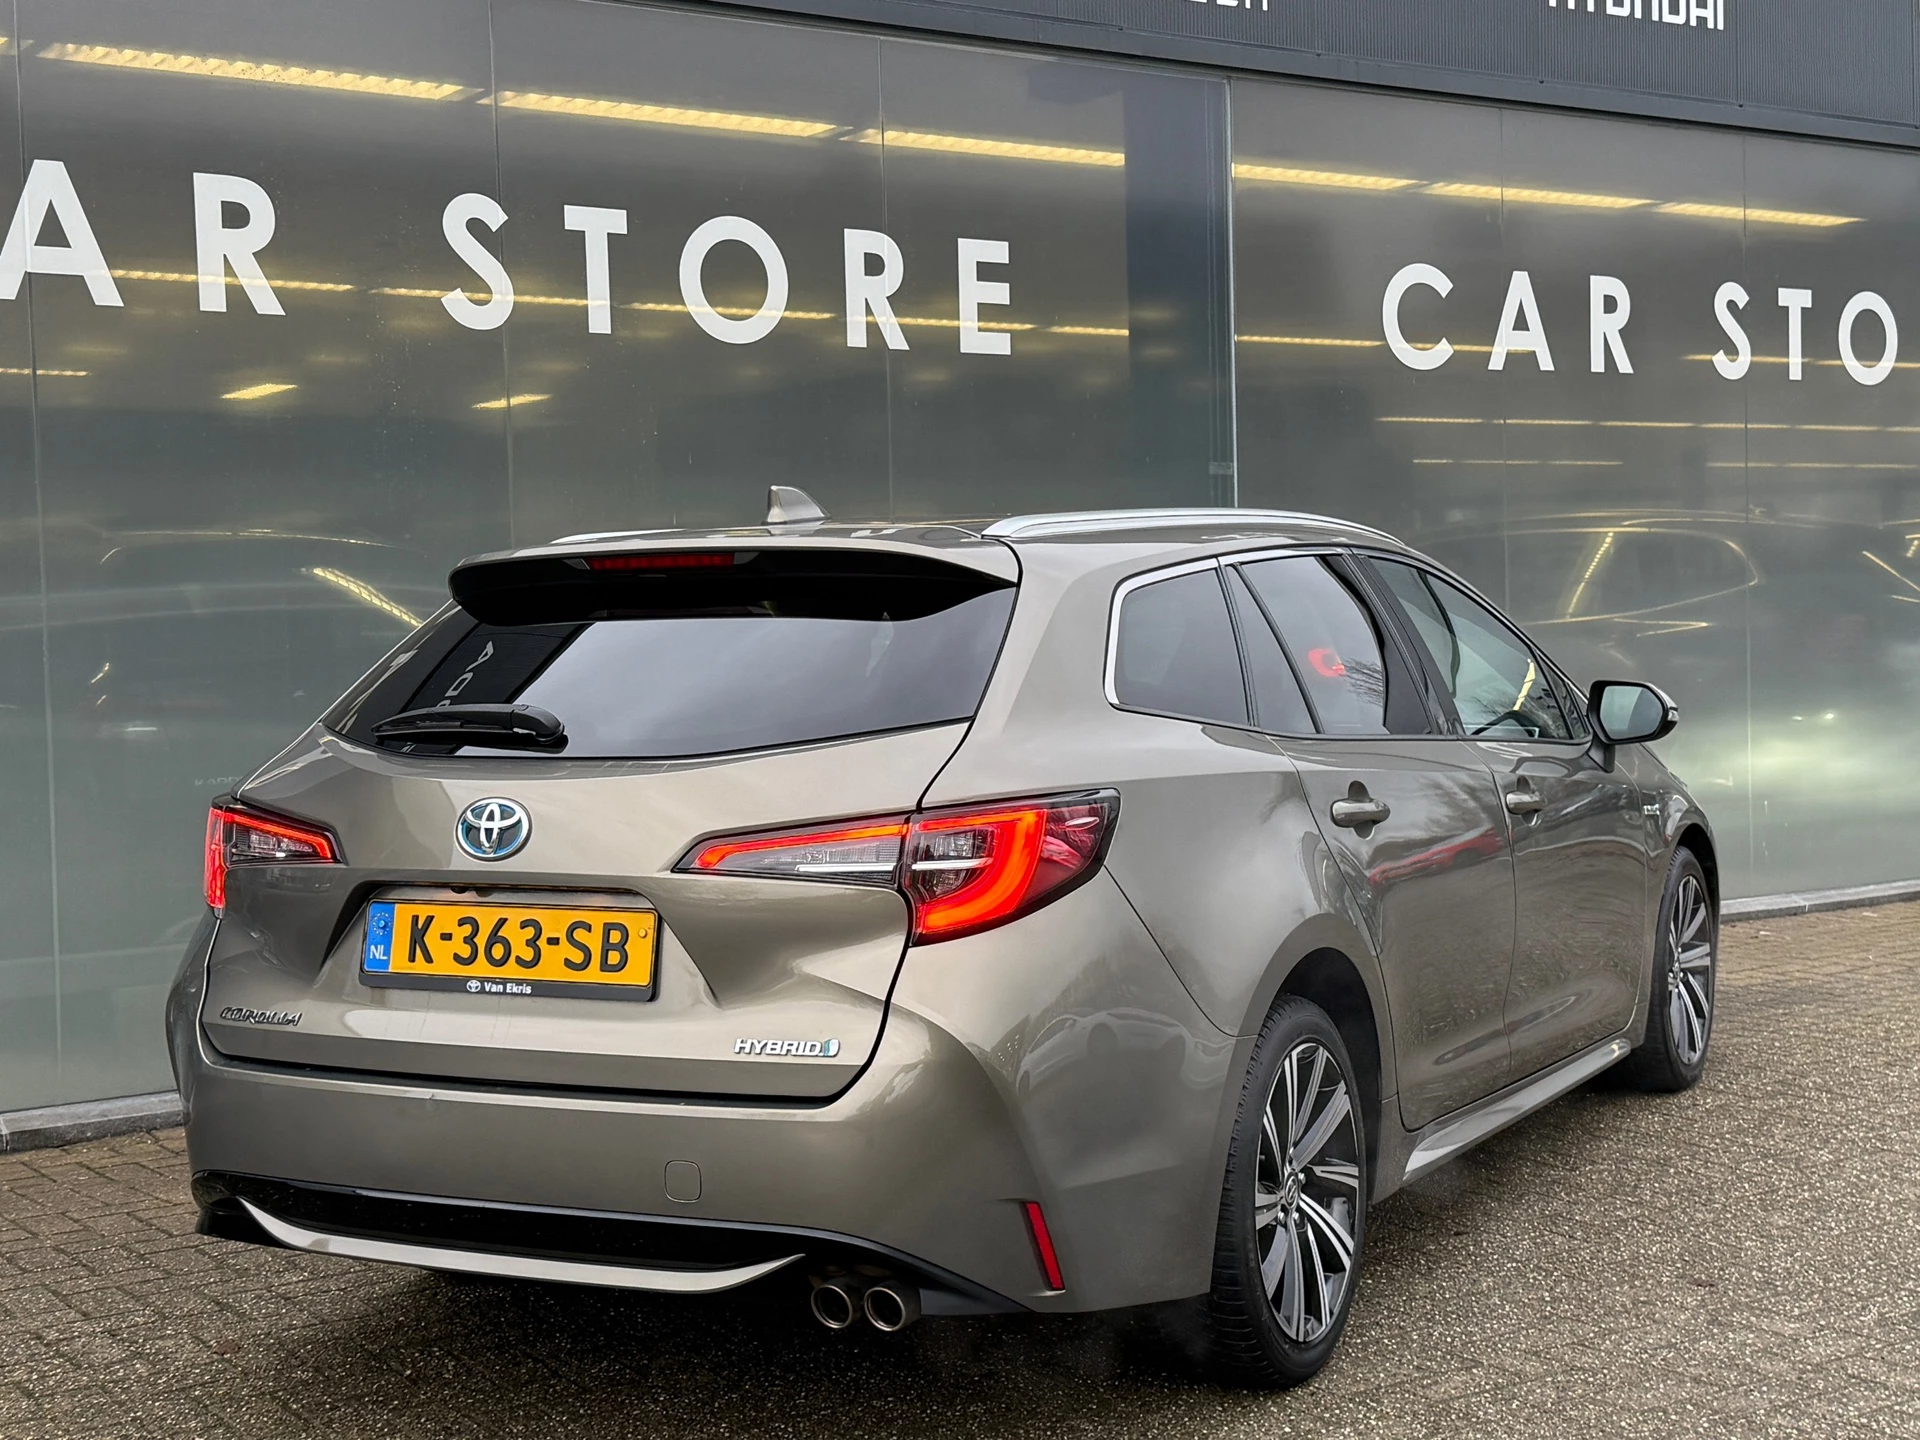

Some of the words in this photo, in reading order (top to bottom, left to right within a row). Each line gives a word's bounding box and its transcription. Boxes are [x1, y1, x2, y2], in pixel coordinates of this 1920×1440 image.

[441, 193, 1012, 356] STORE
[1382, 263, 1634, 374] CAR
[1712, 281, 1899, 386] STO
[370, 944, 388, 960] NL
[407, 914, 630, 973] K-363-SB
[484, 982, 503, 993] Van
[506, 983, 532, 994] Ekris
[220, 1006, 303, 1027] COROLLA
[733, 1038, 822, 1056] HYBRID
